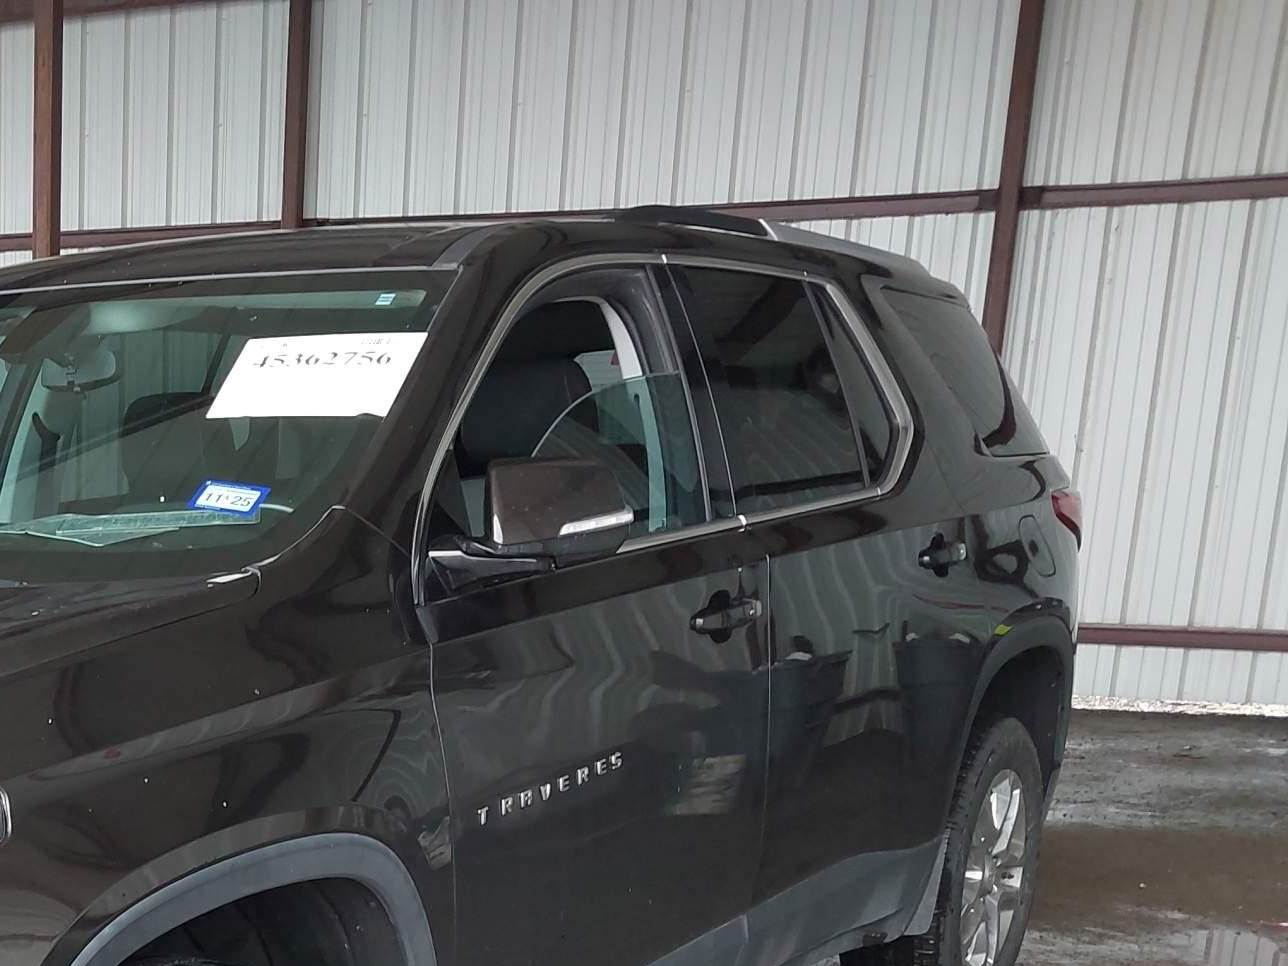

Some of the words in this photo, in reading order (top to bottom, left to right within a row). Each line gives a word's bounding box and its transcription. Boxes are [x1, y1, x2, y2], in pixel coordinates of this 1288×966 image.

[253, 351, 392, 368] 45362756
[205, 492, 223, 503] 11
[230, 495, 253, 507] 25
